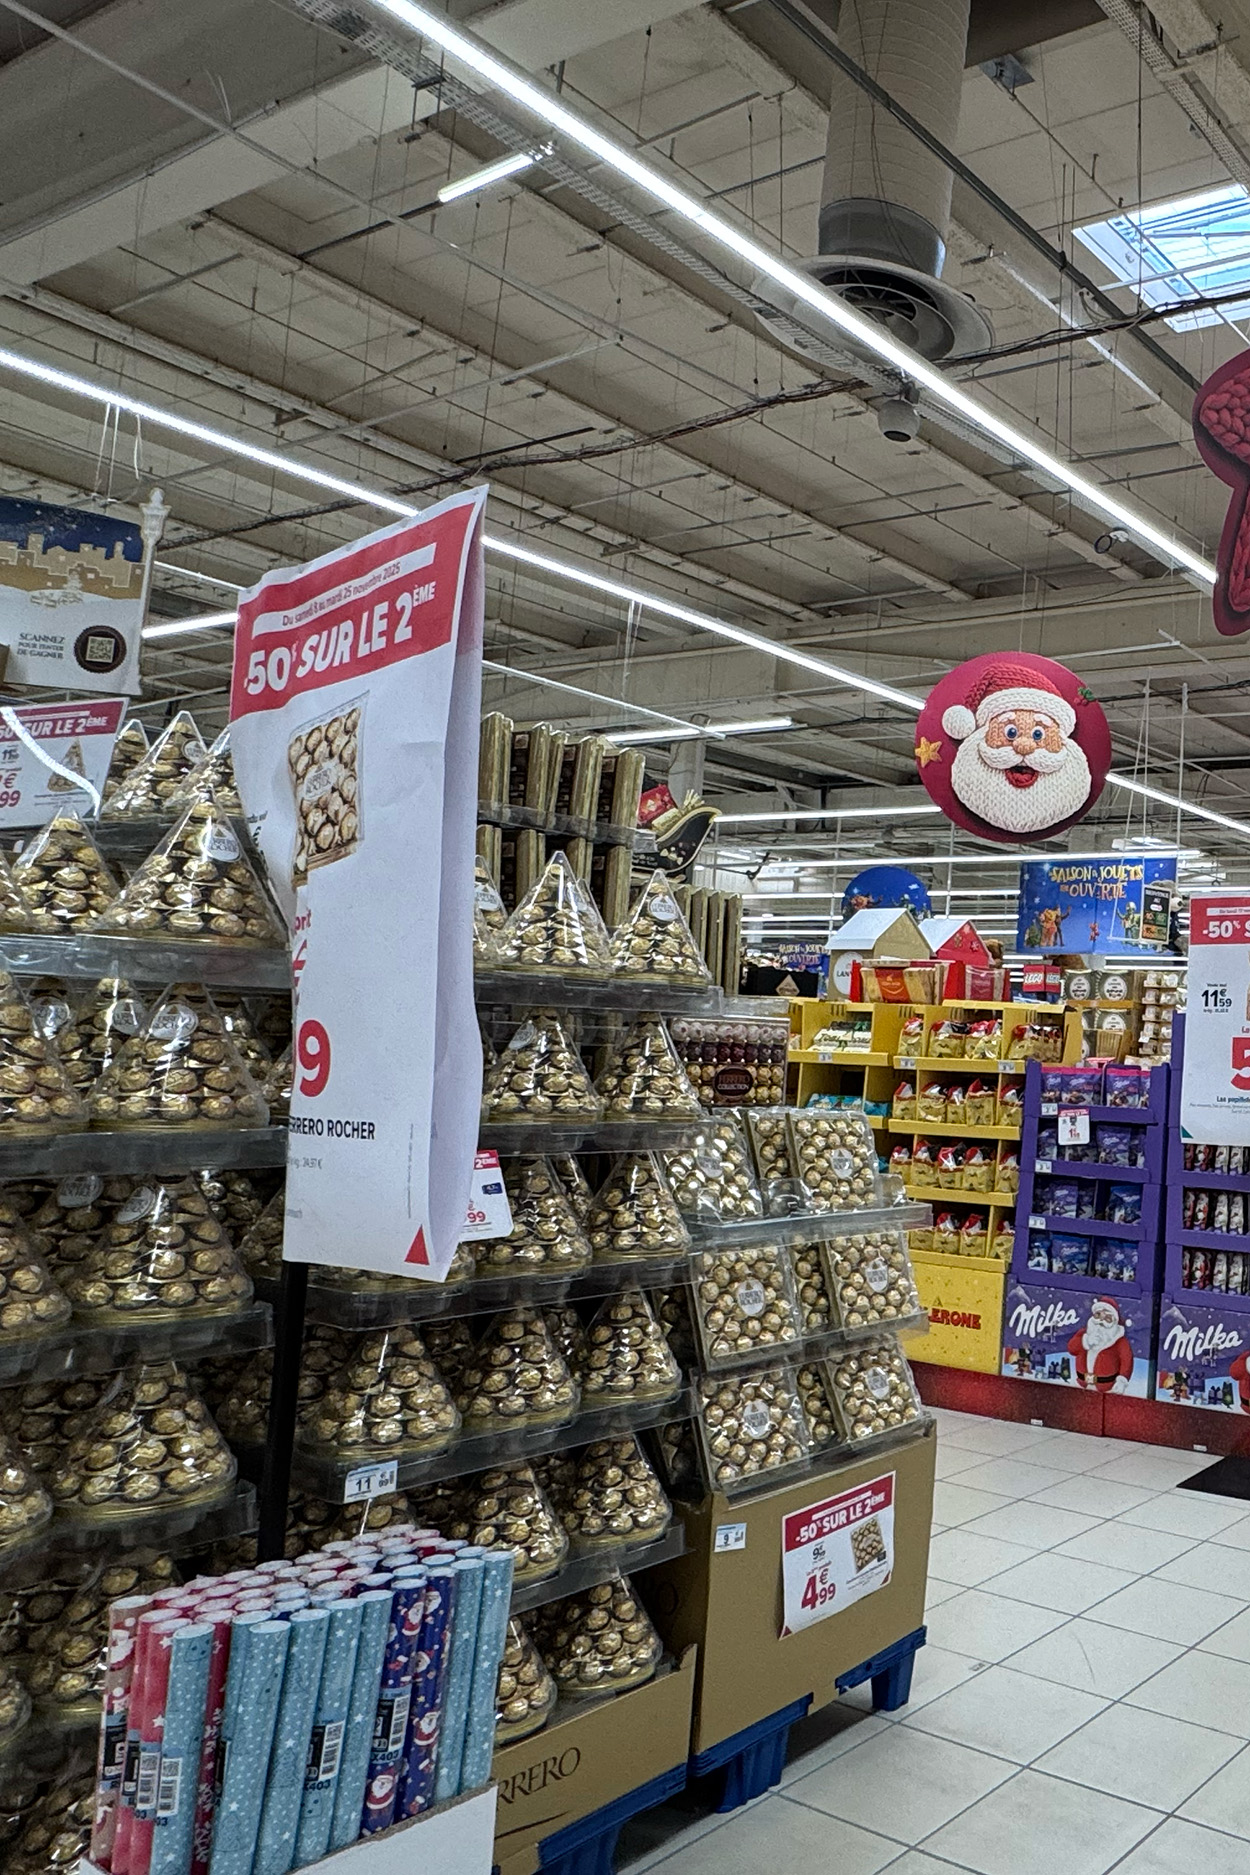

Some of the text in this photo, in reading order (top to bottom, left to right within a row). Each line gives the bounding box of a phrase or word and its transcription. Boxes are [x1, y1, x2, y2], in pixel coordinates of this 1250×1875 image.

[295, 619, 354, 678] SUR
[357, 601, 389, 658] LE
[54, 718, 75, 734] LE
[836, 970, 851, 978] LAN
[1025, 973, 1043, 984] LEGO
[327, 1119, 376, 1140] ROCHER
[1009, 1301, 1080, 1339] Milka
[1164, 1323, 1243, 1361] Milka
[822, 1512, 848, 1533] SUR
[850, 1502, 863, 1520] LE
[498, 1747, 581, 1804] RRERO
